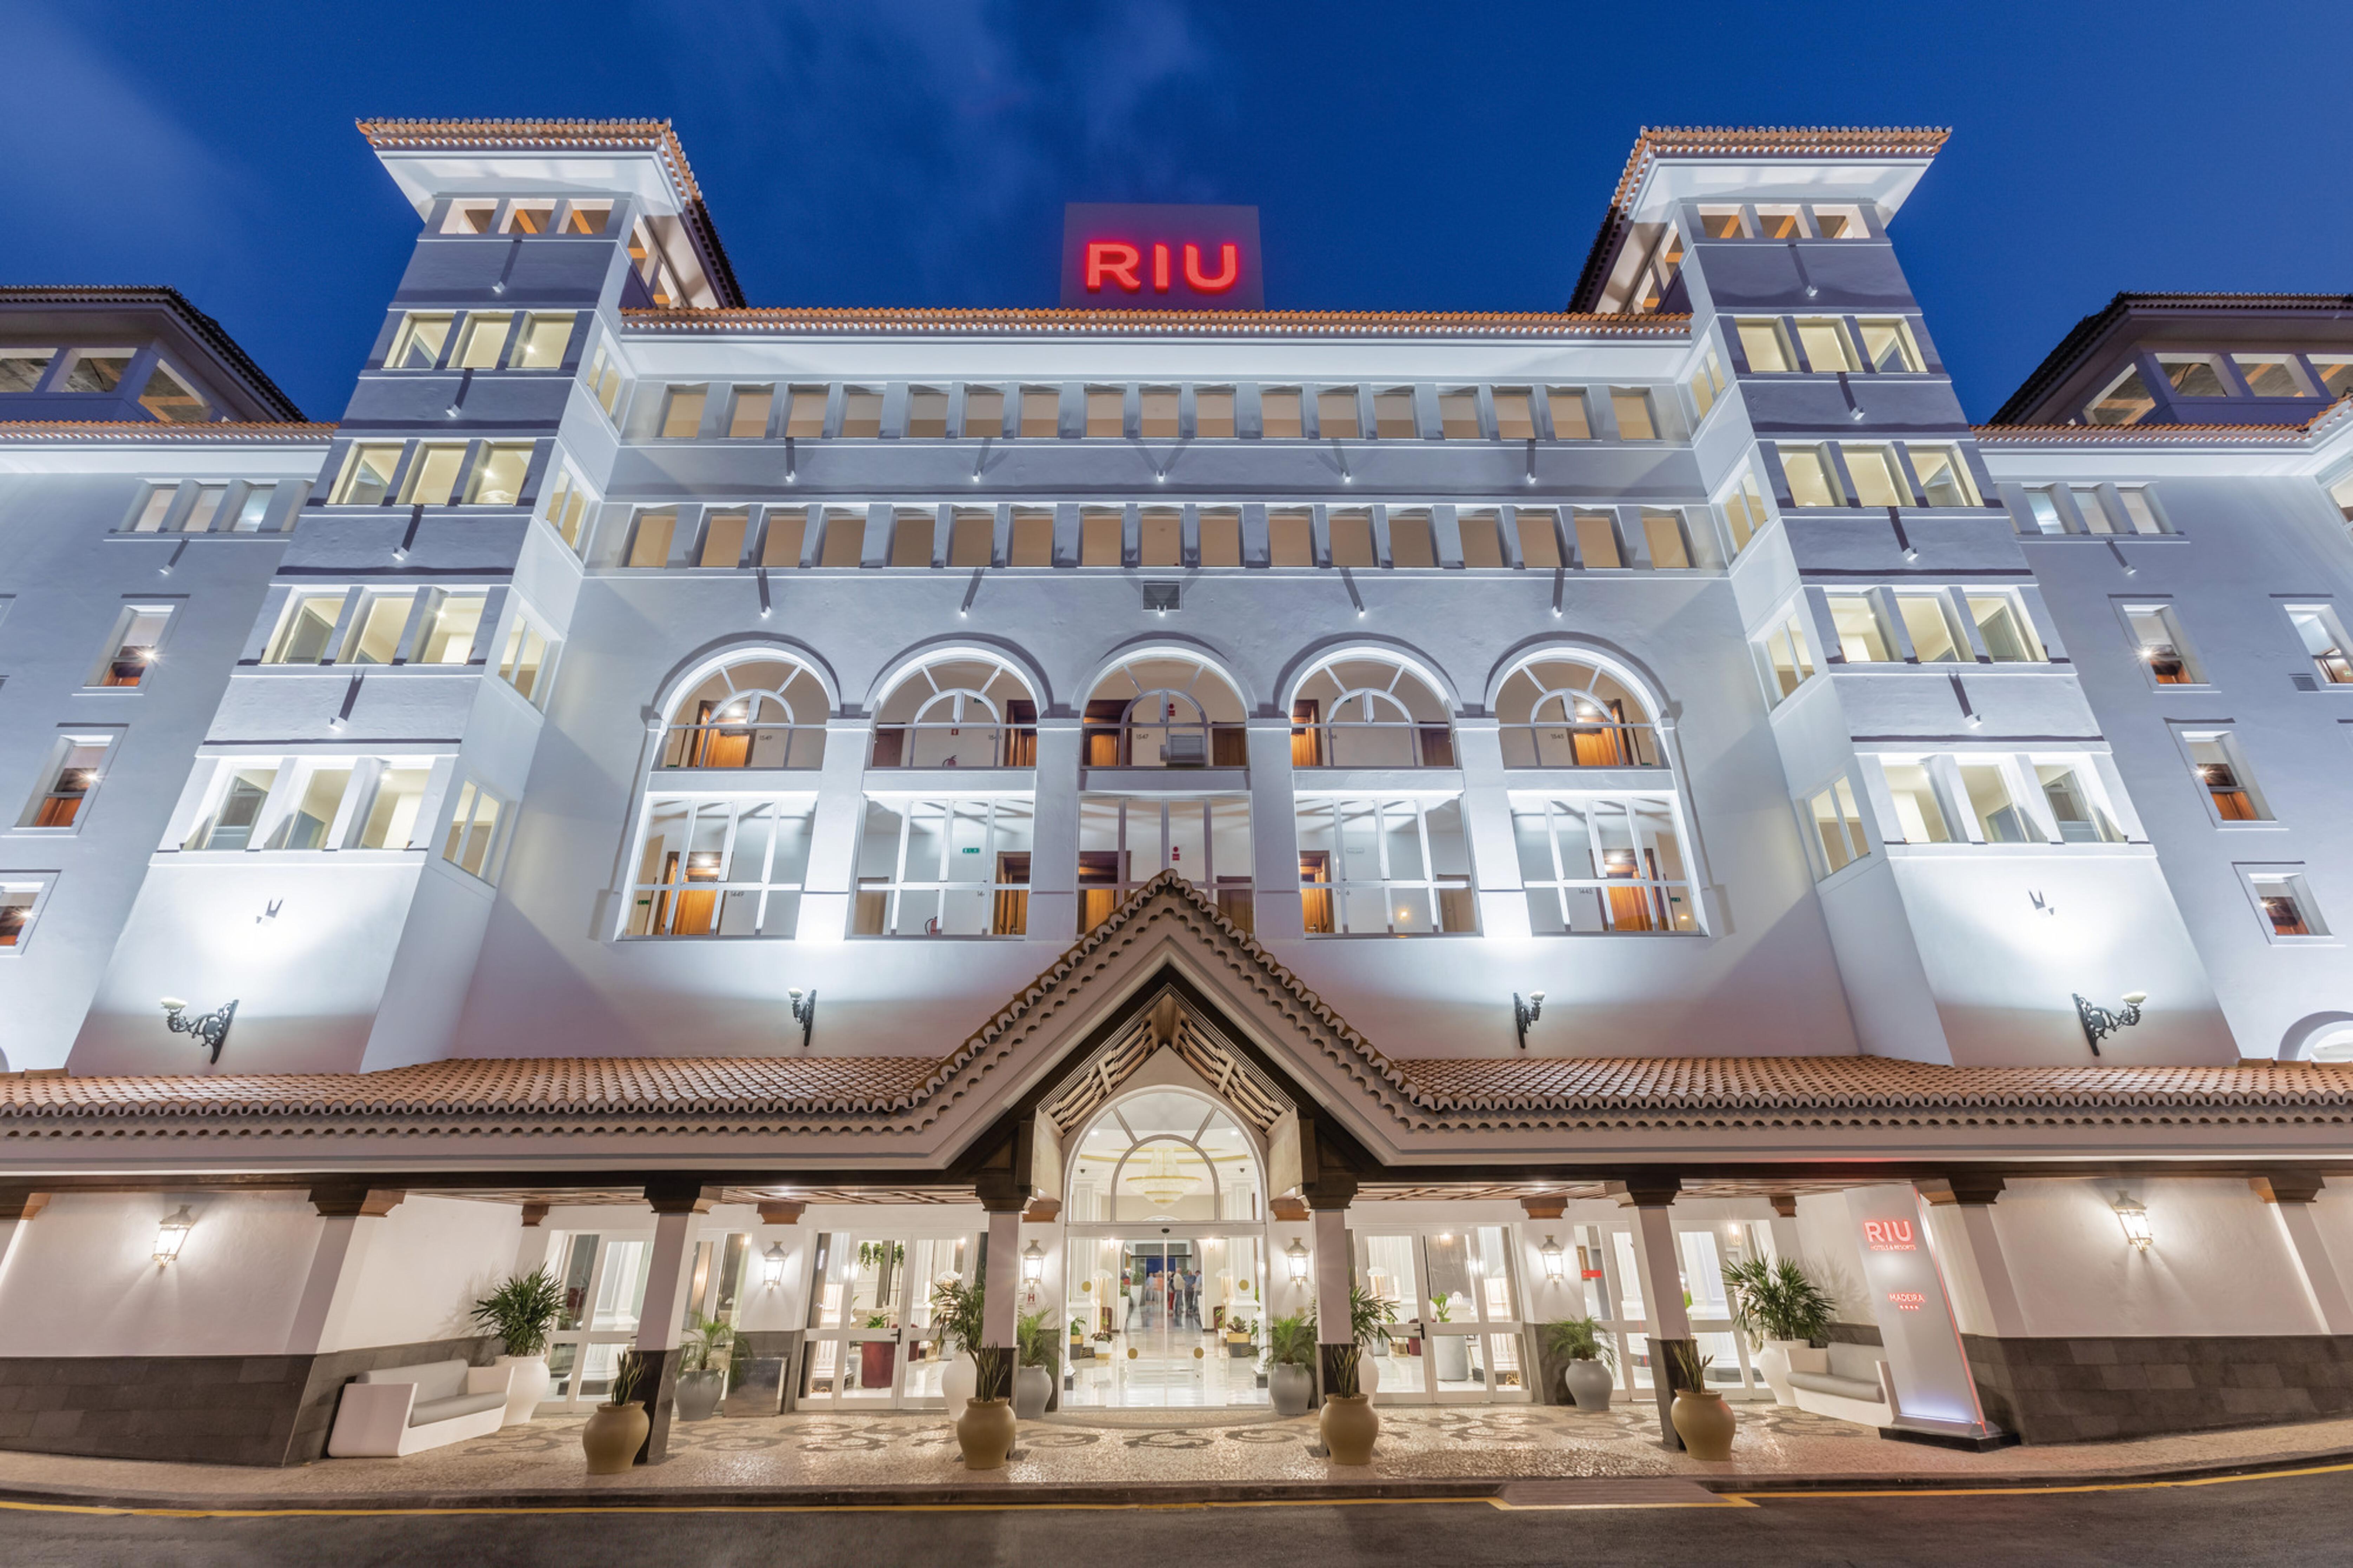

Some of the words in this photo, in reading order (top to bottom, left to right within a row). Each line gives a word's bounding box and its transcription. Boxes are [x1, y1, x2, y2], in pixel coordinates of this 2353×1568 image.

[1087, 243, 1238, 293] RIU
[1864, 1220, 1912, 1242] RIU
[1028, 1293, 1035, 1302] H
[1889, 1293, 1925, 1303] MADEIRA
